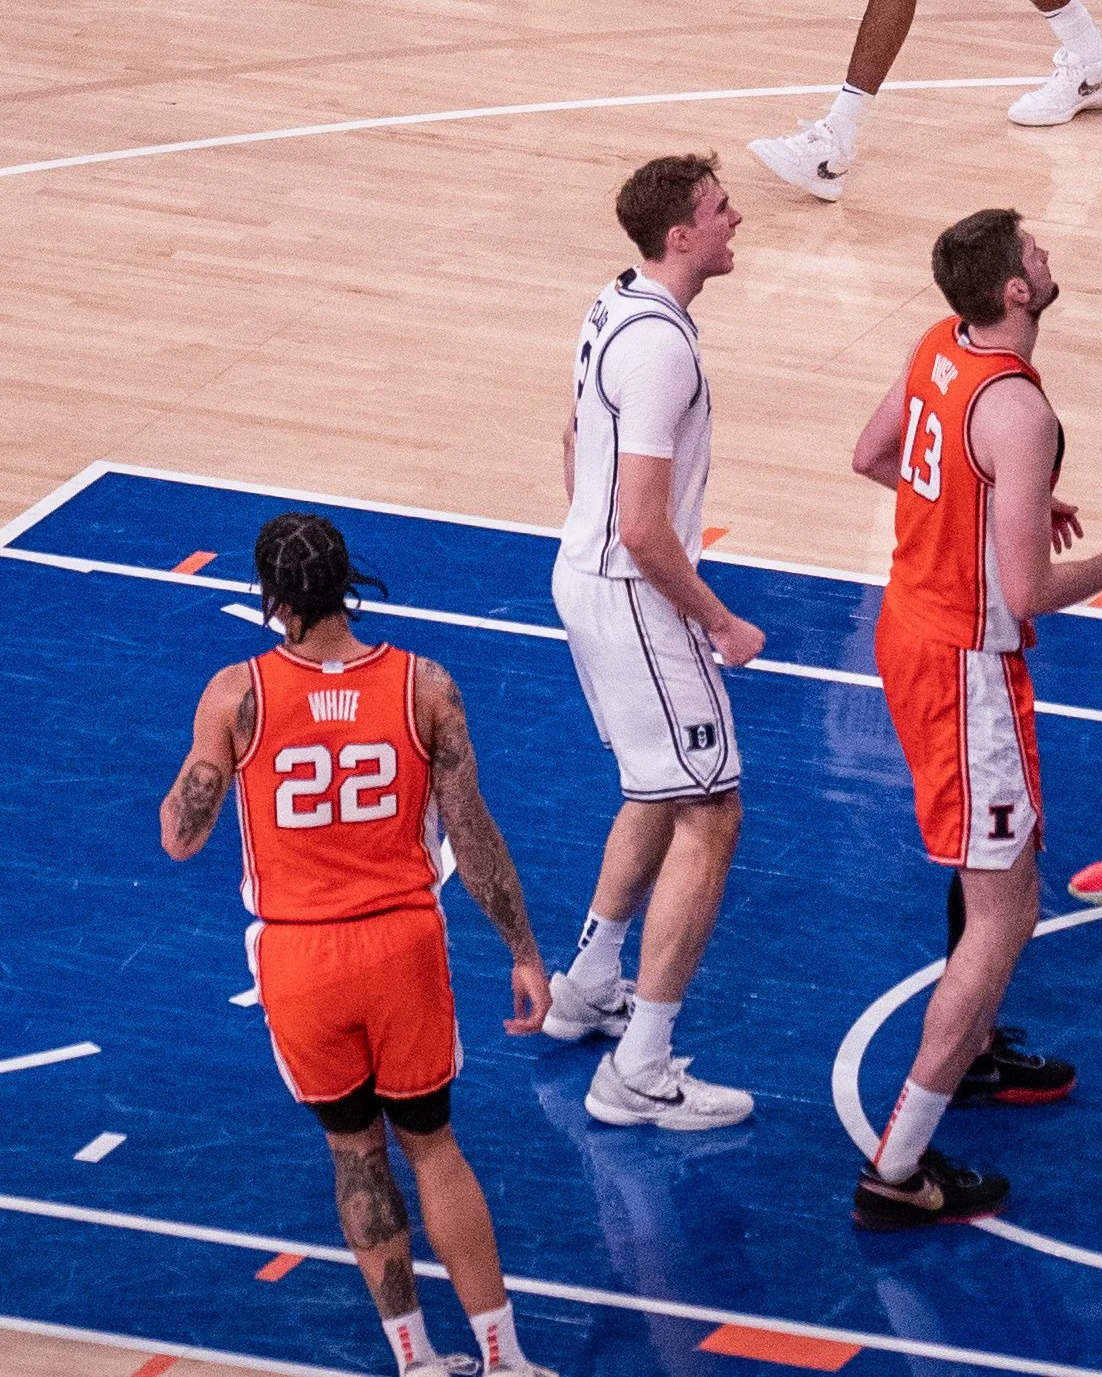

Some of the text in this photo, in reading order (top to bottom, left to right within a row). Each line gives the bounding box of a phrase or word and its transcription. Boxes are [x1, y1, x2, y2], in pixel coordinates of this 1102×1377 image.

[900, 396, 943, 503] 13
[308, 689, 361, 723] WHITE
[274, 741, 398, 829] 22
[988, 803, 1015, 840] I
